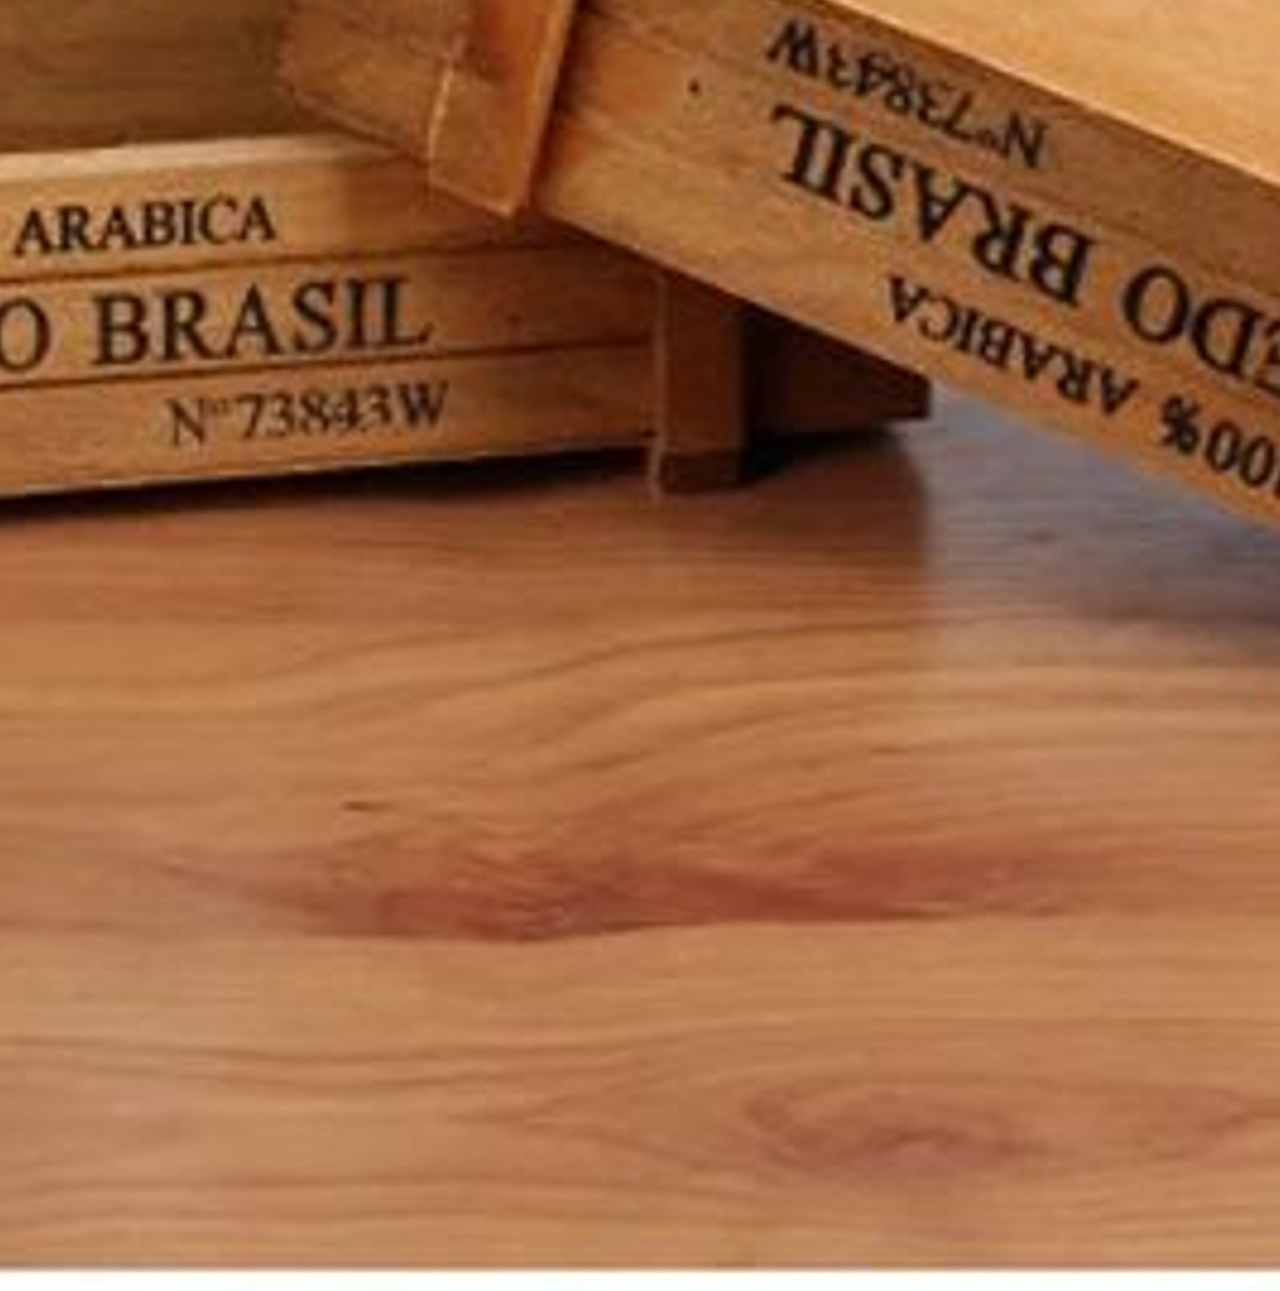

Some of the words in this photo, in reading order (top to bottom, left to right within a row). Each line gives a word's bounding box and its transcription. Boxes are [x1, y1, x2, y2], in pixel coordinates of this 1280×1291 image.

[11, 194, 277, 259] ARABICA
[772, 105, 1096, 307] BRASIL
[91, 277, 435, 367] BRASIL
[889, 275, 1141, 417] ARABICA
